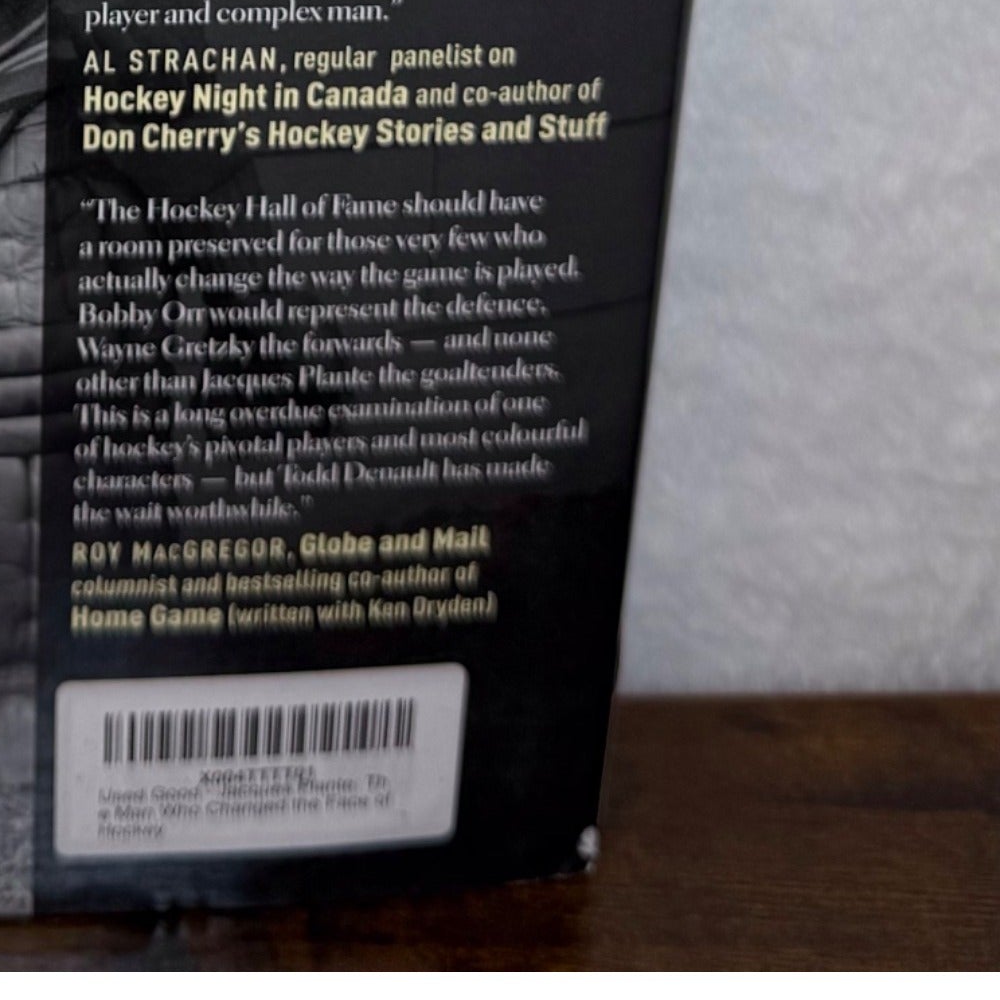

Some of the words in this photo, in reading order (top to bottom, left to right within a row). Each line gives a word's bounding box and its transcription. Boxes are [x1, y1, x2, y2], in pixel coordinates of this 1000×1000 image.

[84, 0, 160, 31] player
[163, 0, 211, 23] and
[82, 49, 116, 74] AL
[129, 46, 288, 74] STRACHAN,
[293, 45, 377, 75] regular
[390, 43, 482, 74] panelist
[488, 46, 517, 67] on
[82, 84, 187, 116] Hockey
[192, 83, 268, 115] Night
[273, 82, 300, 108] in
[305, 80, 410, 107] Canada
[414, 82, 459, 105] and
[461, 79, 575, 104] co-author
[576, 77, 604, 104] of
[81, 123, 136, 150] Don
[141, 121, 261, 153] Cherry’s
[267, 119, 371, 150] Hockey
[374, 116, 477, 144] Stories
[480, 114, 535, 141] and
[537, 111, 609, 139] Stuff
[72, 541, 120, 567] ROY
[299, 532, 376, 561] Globe
[378, 528, 427, 556] and
[432, 526, 489, 552] Mail
[70, 574, 177, 599] columnist
[181, 573, 221, 597] and
[225, 567, 346, 597] bestselling
[347, 564, 448, 589] co-author
[454, 561, 480, 586] of
[70, 604, 144, 632] Home
[149, 602, 223, 629] Game
[227, 601, 313, 626] (written
[316, 600, 364, 623] with
[367, 598, 410, 623] Ken
[411, 591, 498, 624] Dryden)
